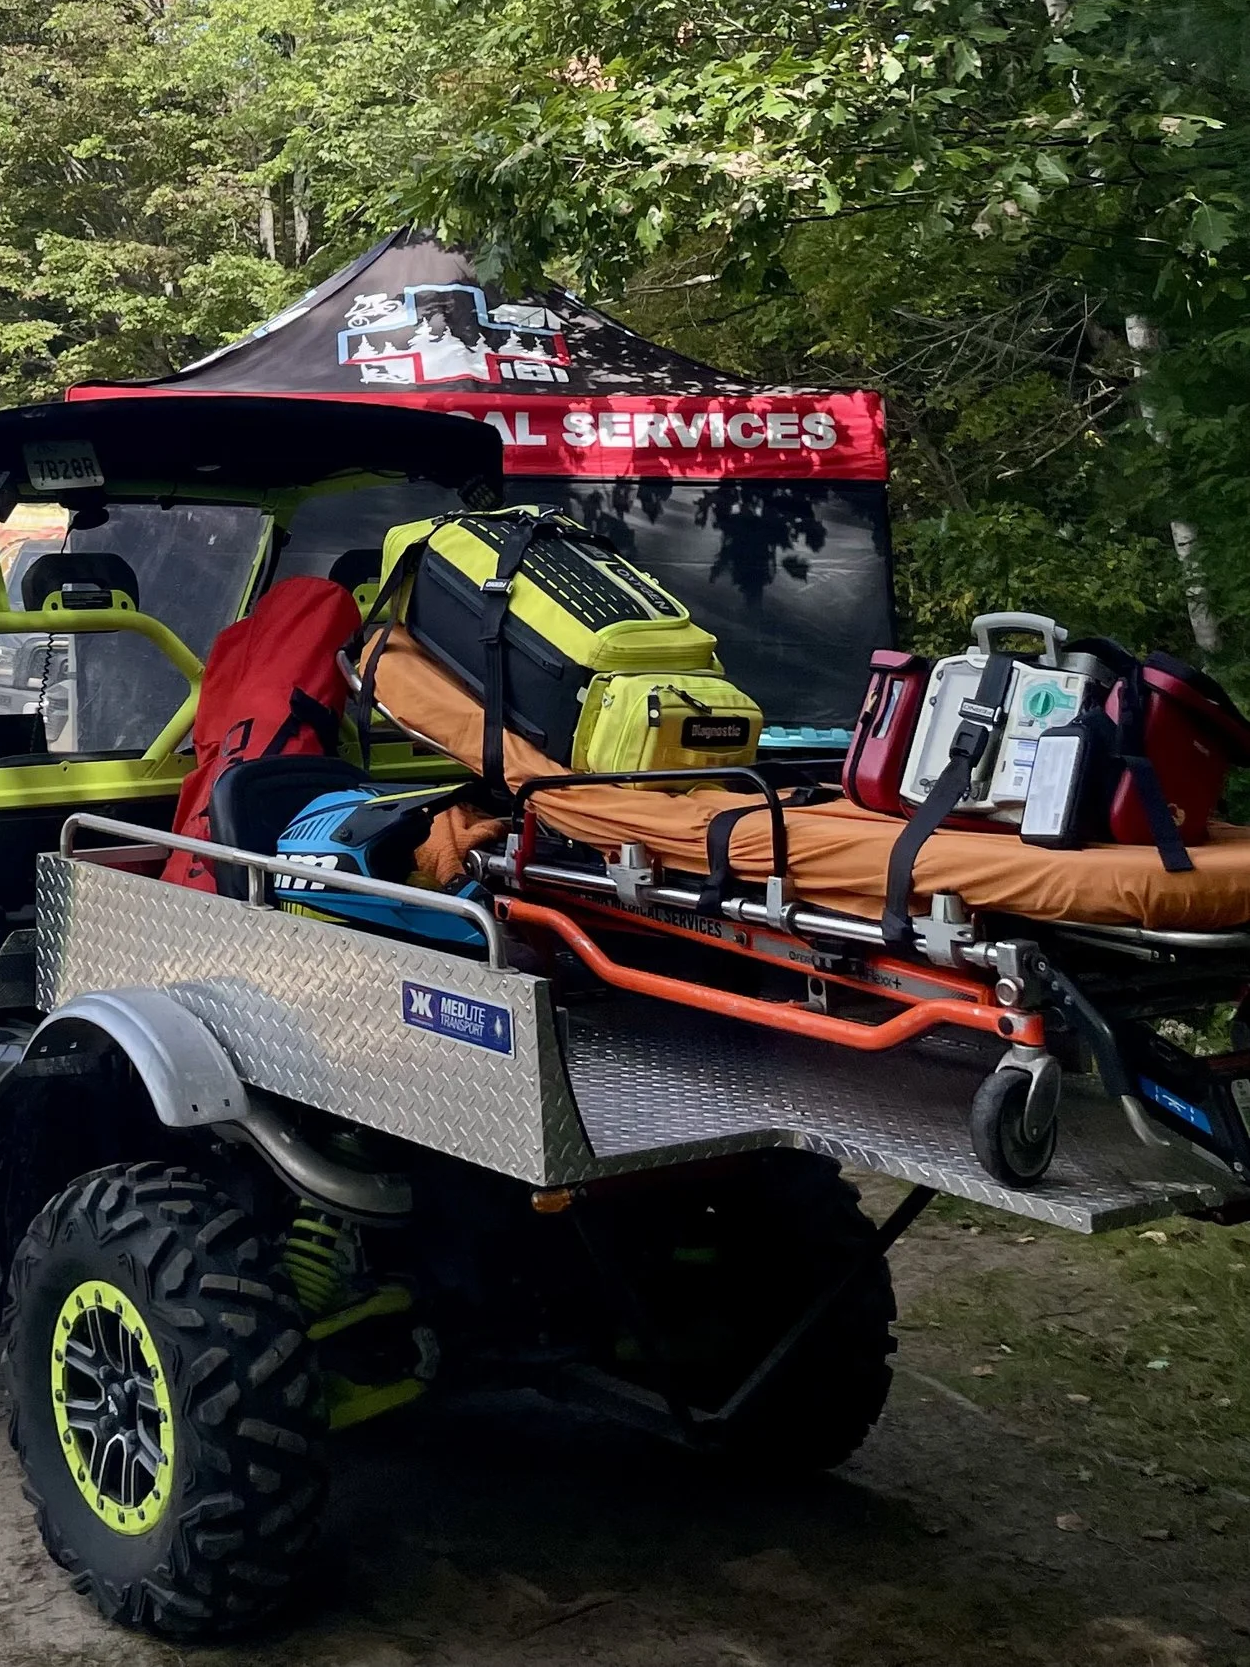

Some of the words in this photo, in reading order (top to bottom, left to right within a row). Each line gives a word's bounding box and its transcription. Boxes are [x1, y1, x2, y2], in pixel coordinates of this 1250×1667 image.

[562, 410, 836, 450] SERVICES
[616, 568, 670, 610] OXYGEN
[691, 723, 742, 740] Diagnostic
[661, 908, 723, 939] SERVICES
[440, 996, 486, 1025] MEDLITE
[440, 1013, 484, 1037] TRANSPORT
